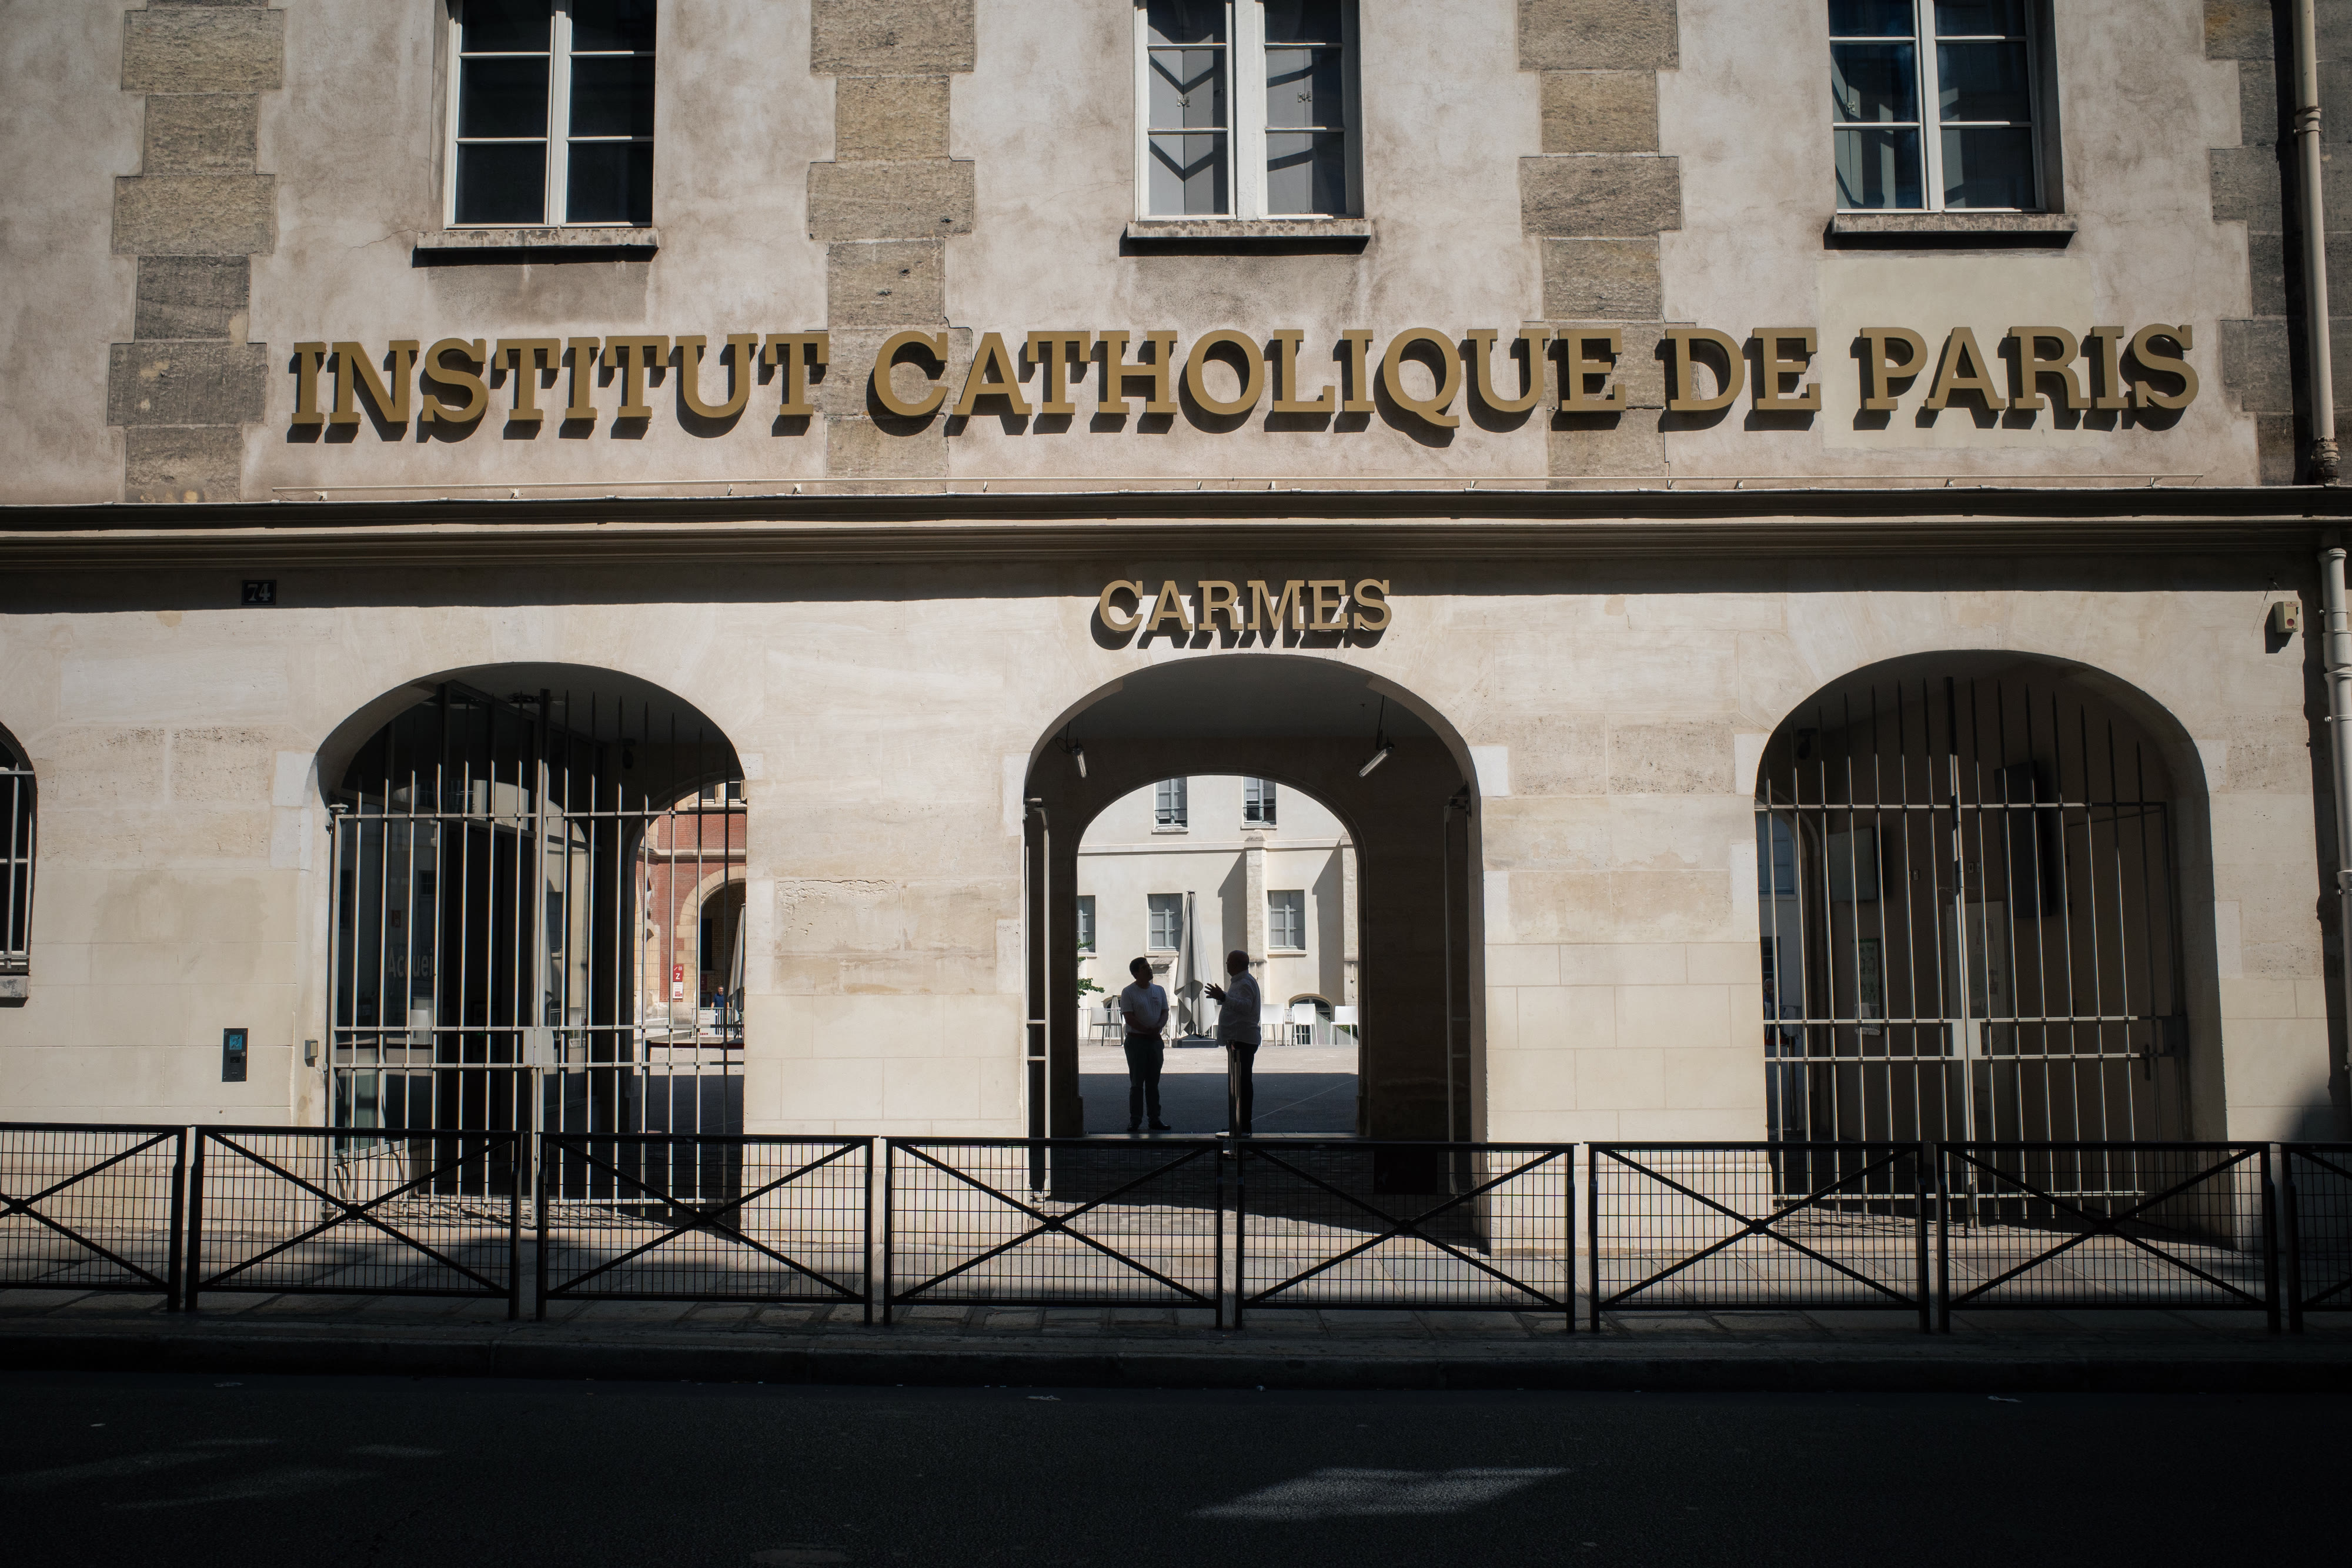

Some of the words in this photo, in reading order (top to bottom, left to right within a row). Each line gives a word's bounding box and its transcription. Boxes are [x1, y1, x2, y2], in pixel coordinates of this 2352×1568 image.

[292, 333, 830, 424] INSTITUT
[874, 327, 1626, 428] CATHOLIQUE
[1665, 327, 1822, 412] DE
[1860, 323, 2199, 411] PARIS
[247, 583, 270, 601] 74
[1099, 579, 1392, 631] CARMES
